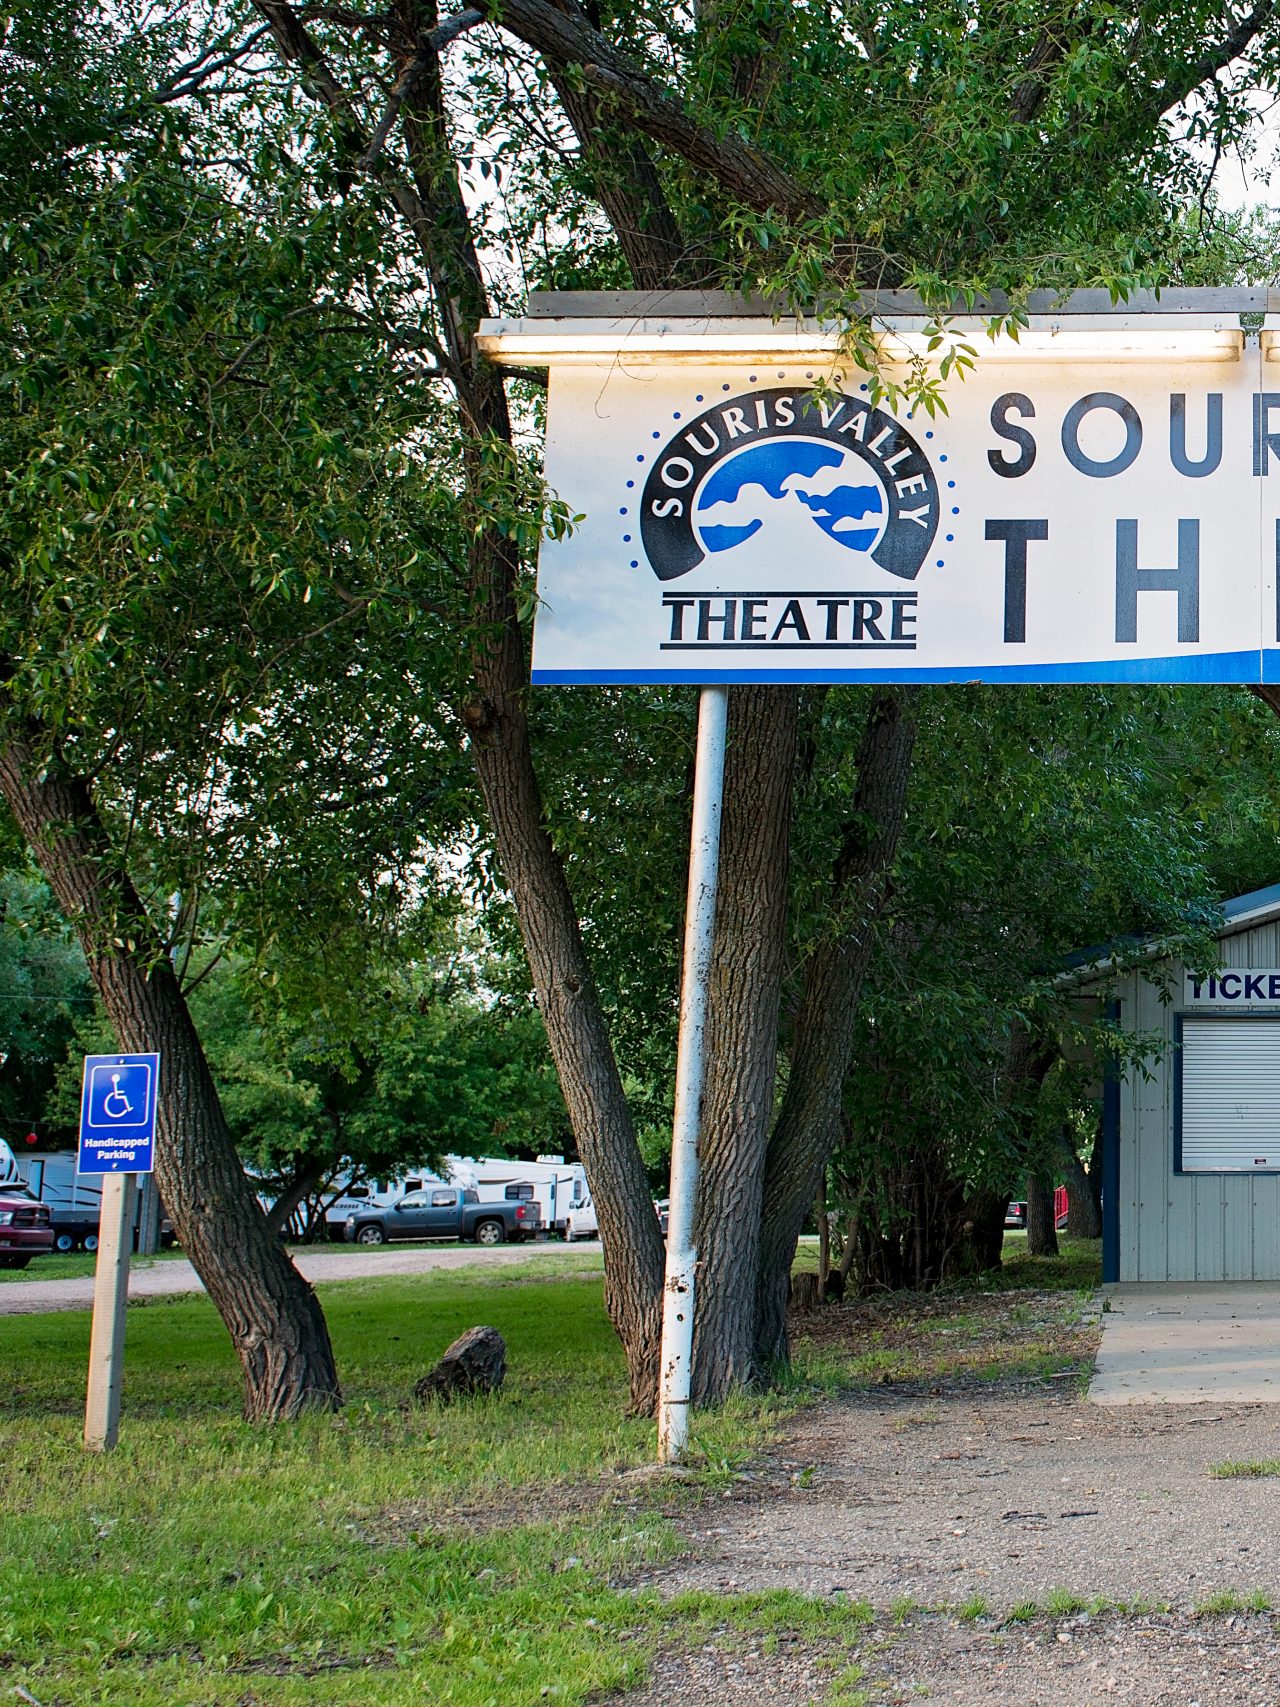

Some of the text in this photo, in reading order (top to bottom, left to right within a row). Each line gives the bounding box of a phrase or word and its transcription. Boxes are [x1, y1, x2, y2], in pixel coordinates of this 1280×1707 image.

[651, 396, 931, 530] SOURIS VALLEY
[661, 599, 918, 641] THEATRE
[84, 1136, 150, 1149] Handicapped
[97, 1150, 136, 1161] Parking
